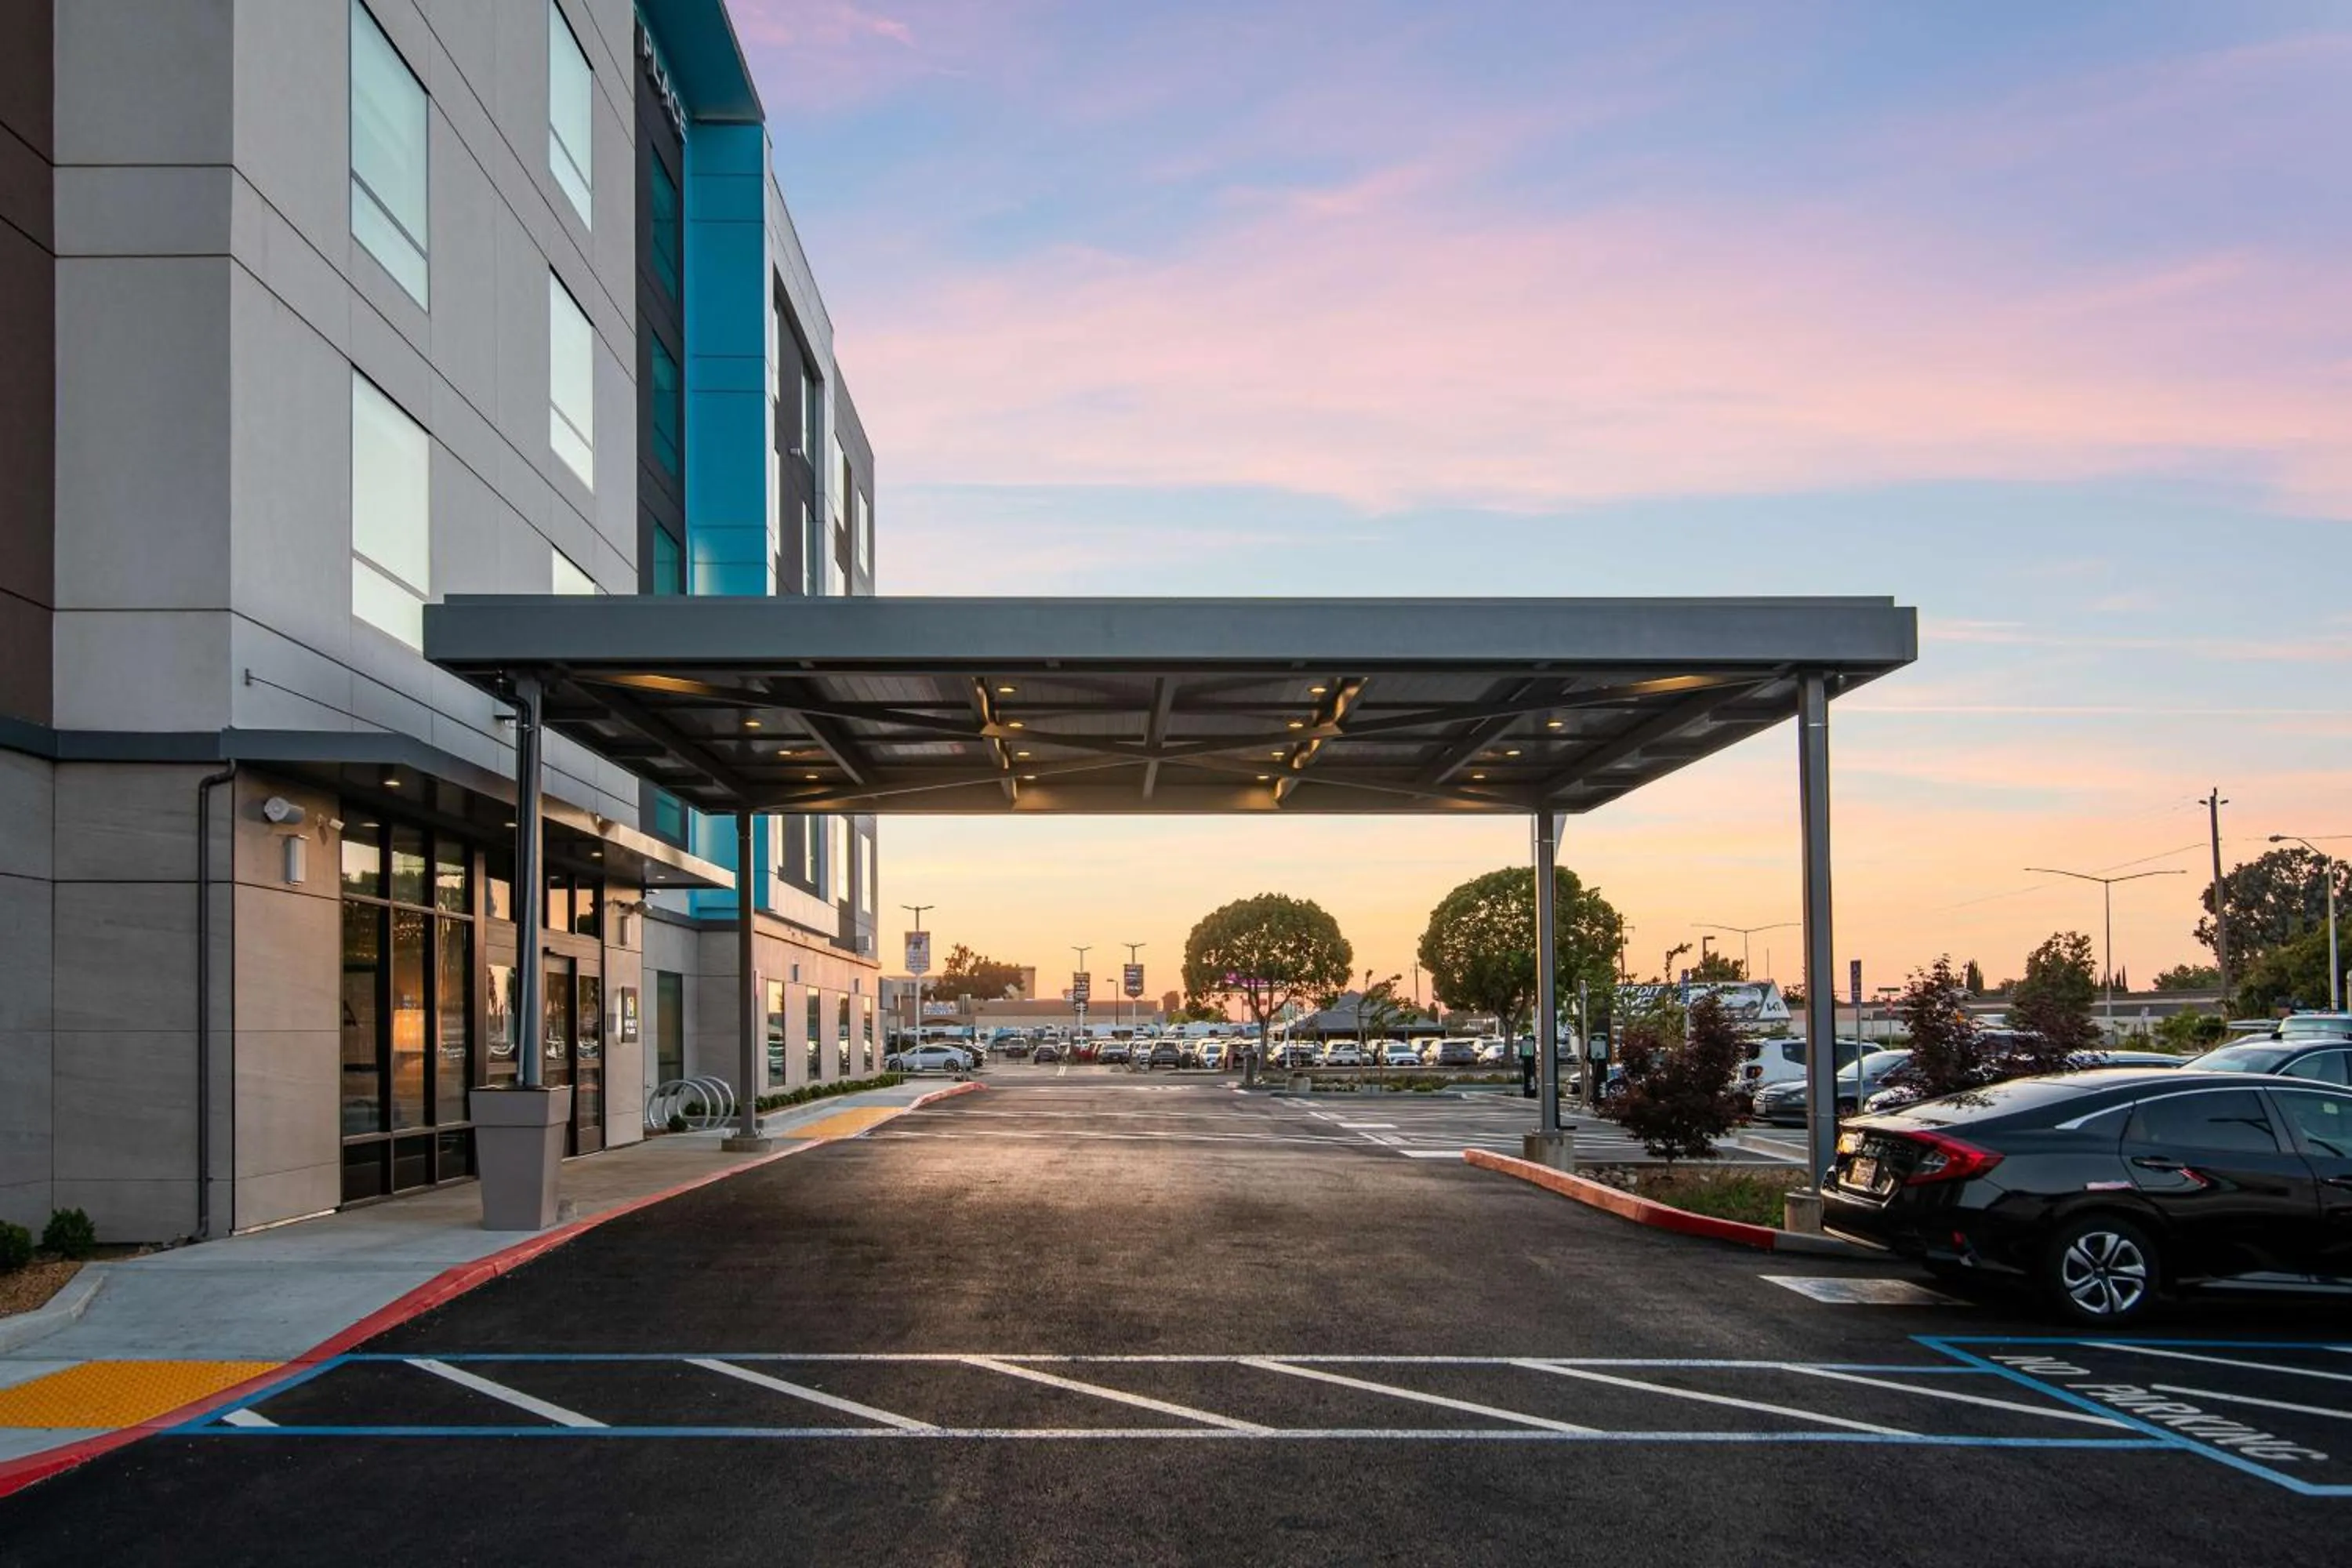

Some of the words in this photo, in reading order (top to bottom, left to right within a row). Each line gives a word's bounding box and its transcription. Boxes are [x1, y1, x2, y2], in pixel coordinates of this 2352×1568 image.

[644, 25, 687, 143] PLACE
[1613, 985, 1664, 996] REDIT
[1989, 1356, 2091, 1375] NO
[2064, 1384, 2328, 1461] PARKING
